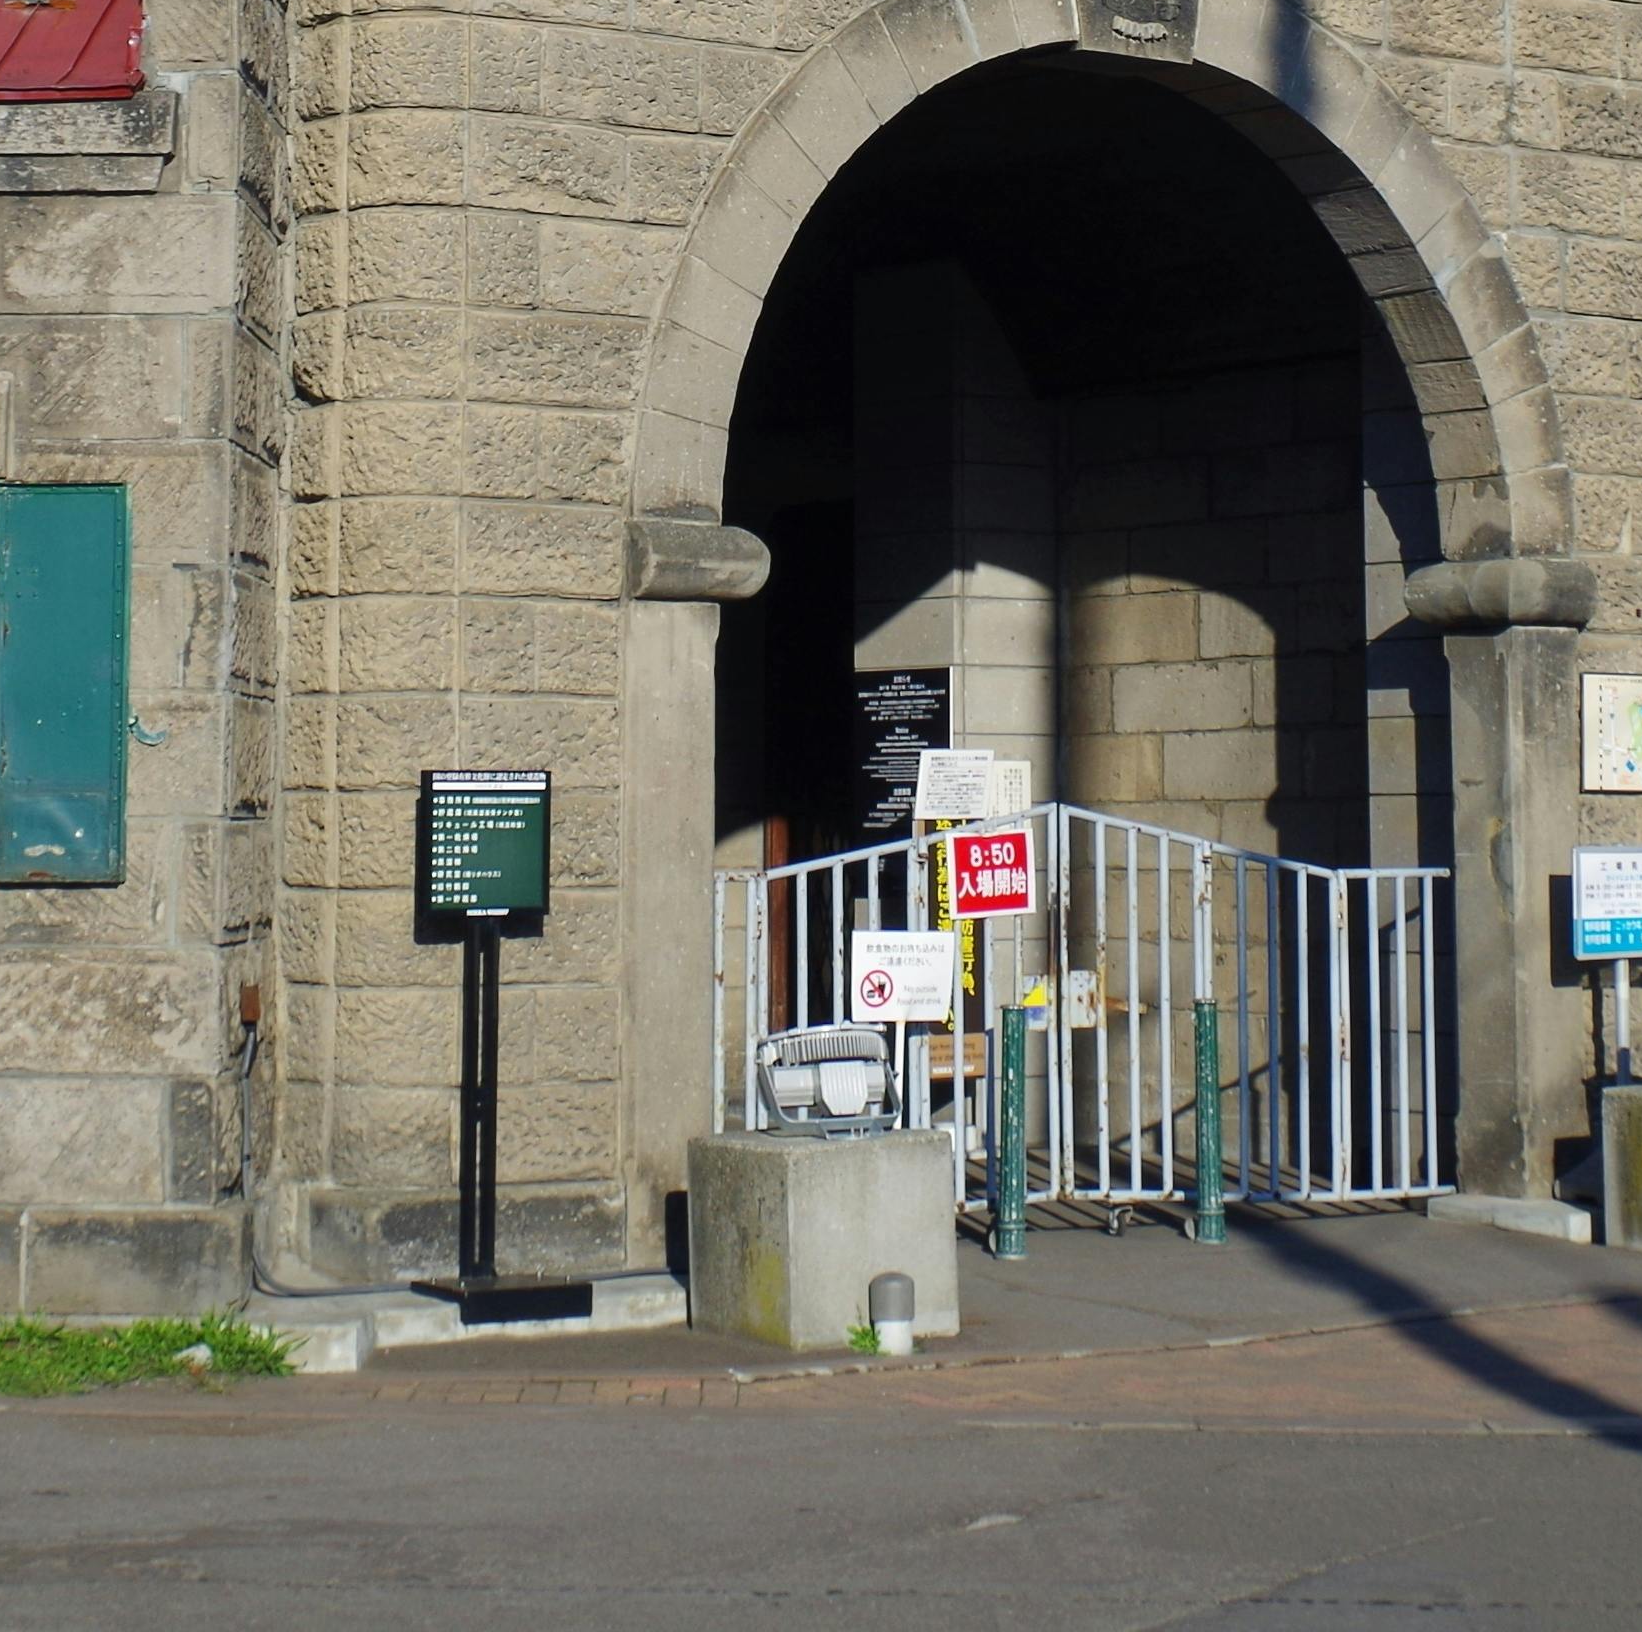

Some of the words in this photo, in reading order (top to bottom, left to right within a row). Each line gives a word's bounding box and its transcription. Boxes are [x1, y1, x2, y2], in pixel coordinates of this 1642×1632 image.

[970, 842, 1016, 868] 8:50
[958, 867, 1027, 899] 入場開始
[866, 943, 945, 954] 飲食物のお持ち込みは
